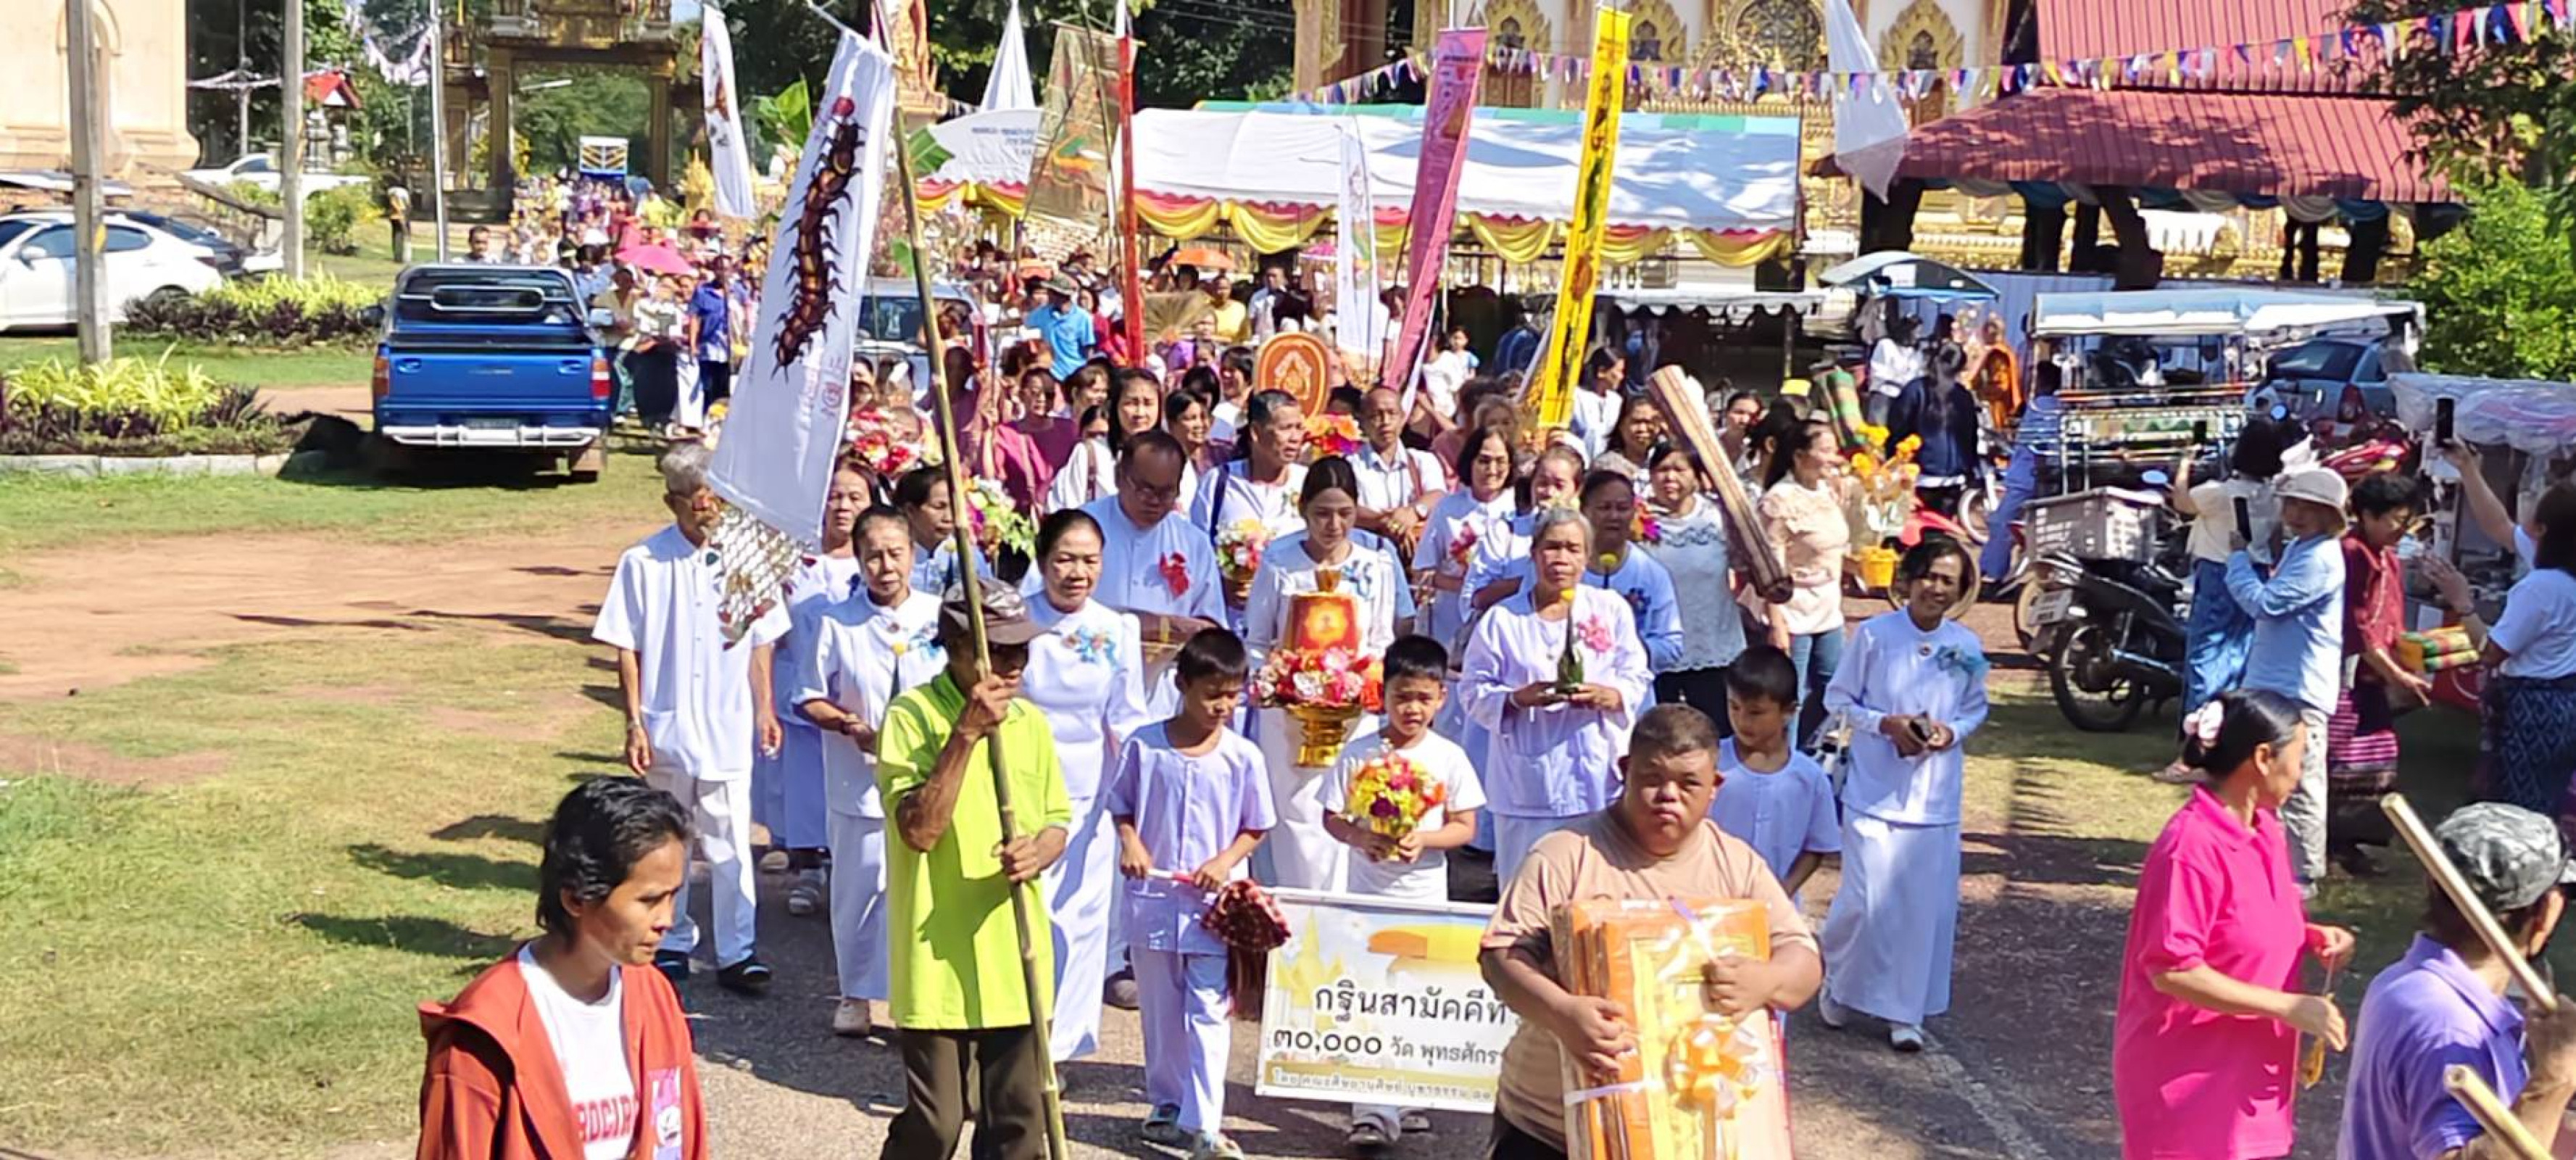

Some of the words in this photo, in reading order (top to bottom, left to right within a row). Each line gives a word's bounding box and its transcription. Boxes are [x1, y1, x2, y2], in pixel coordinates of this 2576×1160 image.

[1316, 979, 1506, 1024] กฐินสามัคคีท
[1274, 1028, 1382, 1056] ๓๐,๐๐๐
[1390, 1036, 1414, 1058] วัด
[1421, 1041, 1499, 1069] พุทธศักร
